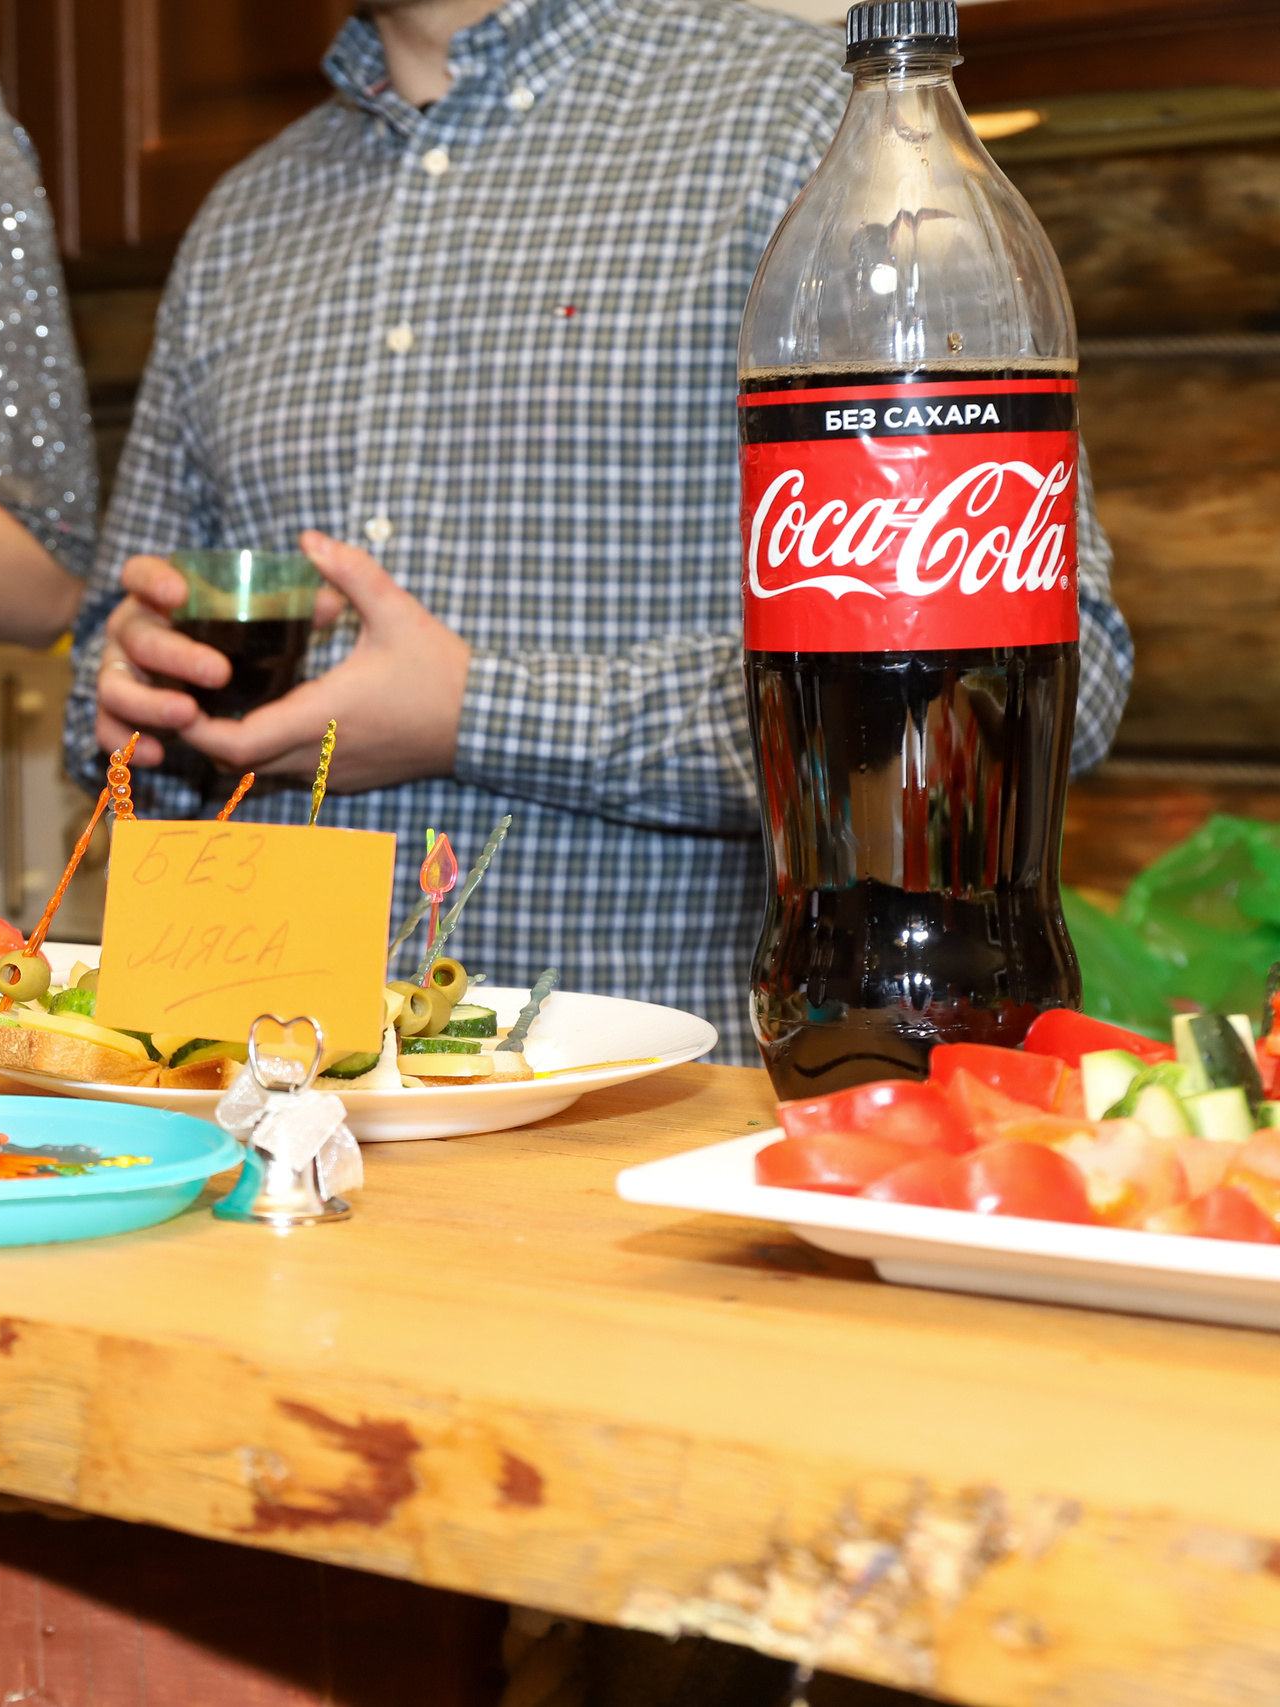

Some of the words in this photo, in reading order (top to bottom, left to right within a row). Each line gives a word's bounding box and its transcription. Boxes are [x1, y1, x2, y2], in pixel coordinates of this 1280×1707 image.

[825, 408, 876, 432] БЕЗ
[883, 402, 1001, 430] САХАРА
[748, 460, 1074, 600] Coca-Cola
[131, 829, 266, 893] БЕЗ
